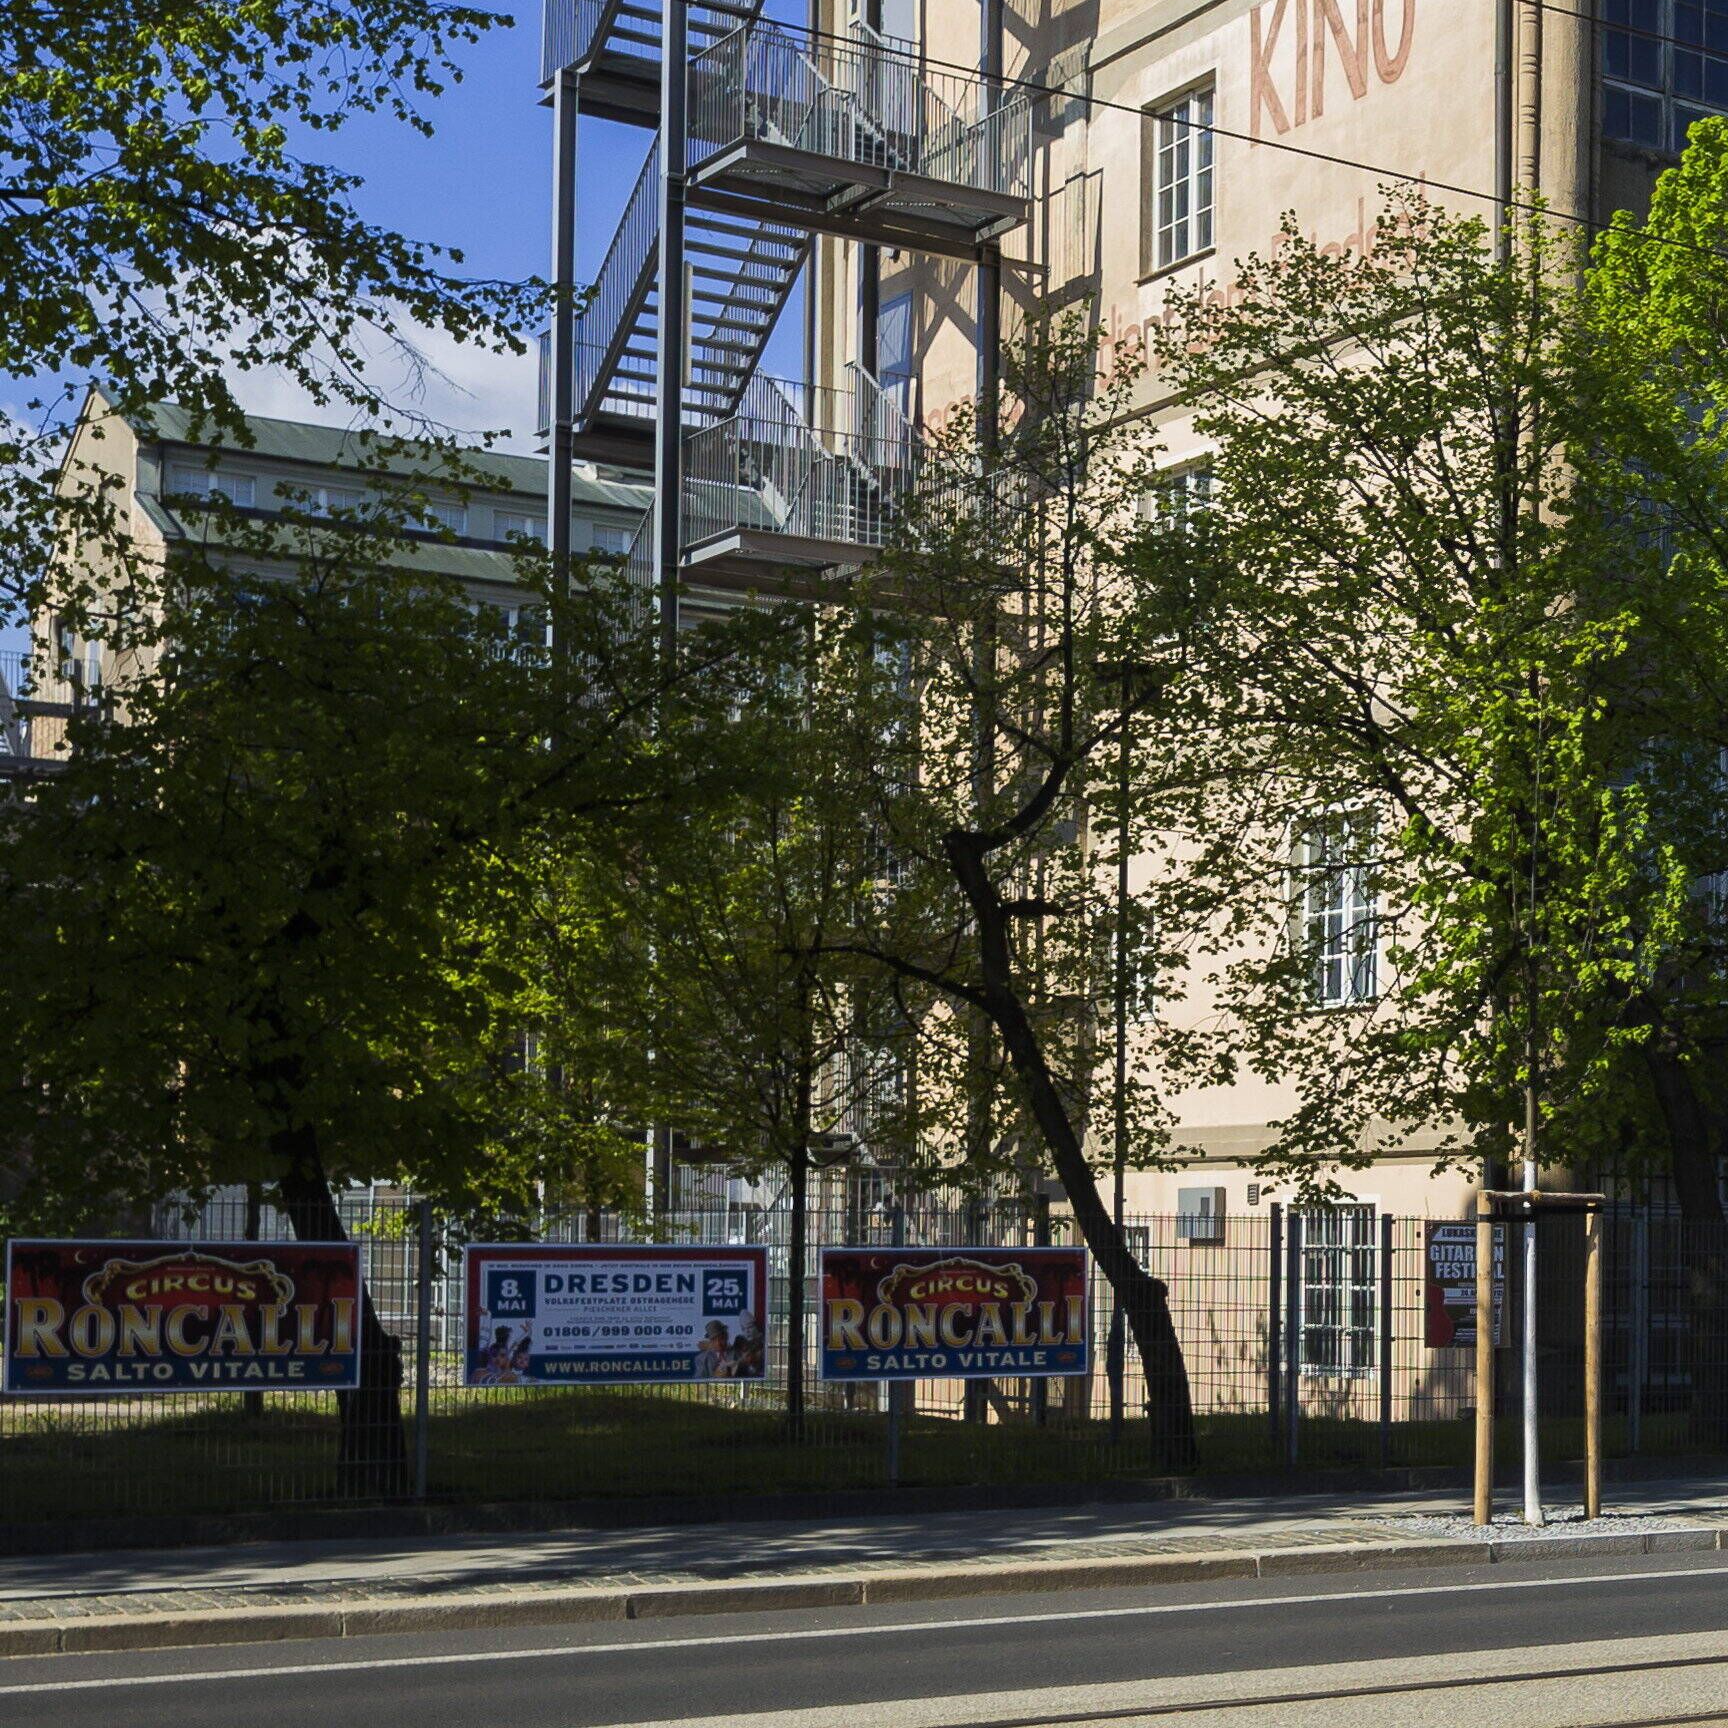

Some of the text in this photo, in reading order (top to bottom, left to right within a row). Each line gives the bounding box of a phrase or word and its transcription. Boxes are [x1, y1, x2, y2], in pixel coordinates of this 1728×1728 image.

[1430, 1244, 1504, 1262] GITARN
[1435, 1262, 1505, 1279] FESTIL
[126, 1273, 256, 1301] CIRCUS
[501, 1279, 522, 1298] 8.
[544, 1273, 696, 1293] DRESDEN
[707, 1279, 743, 1297] 25.
[910, 1274, 1009, 1299] CIRCUS
[497, 1300, 526, 1311] MAI
[712, 1299, 739, 1309] MAI
[14, 1297, 355, 1359] RONCALLI
[827, 1295, 1083, 1351] RONCALLI
[544, 1359, 691, 1374] WWW.RONCALLI.DE
[867, 1352, 1047, 1370] SALTO VITALE
[67, 1361, 305, 1380] SALTO VITALE
